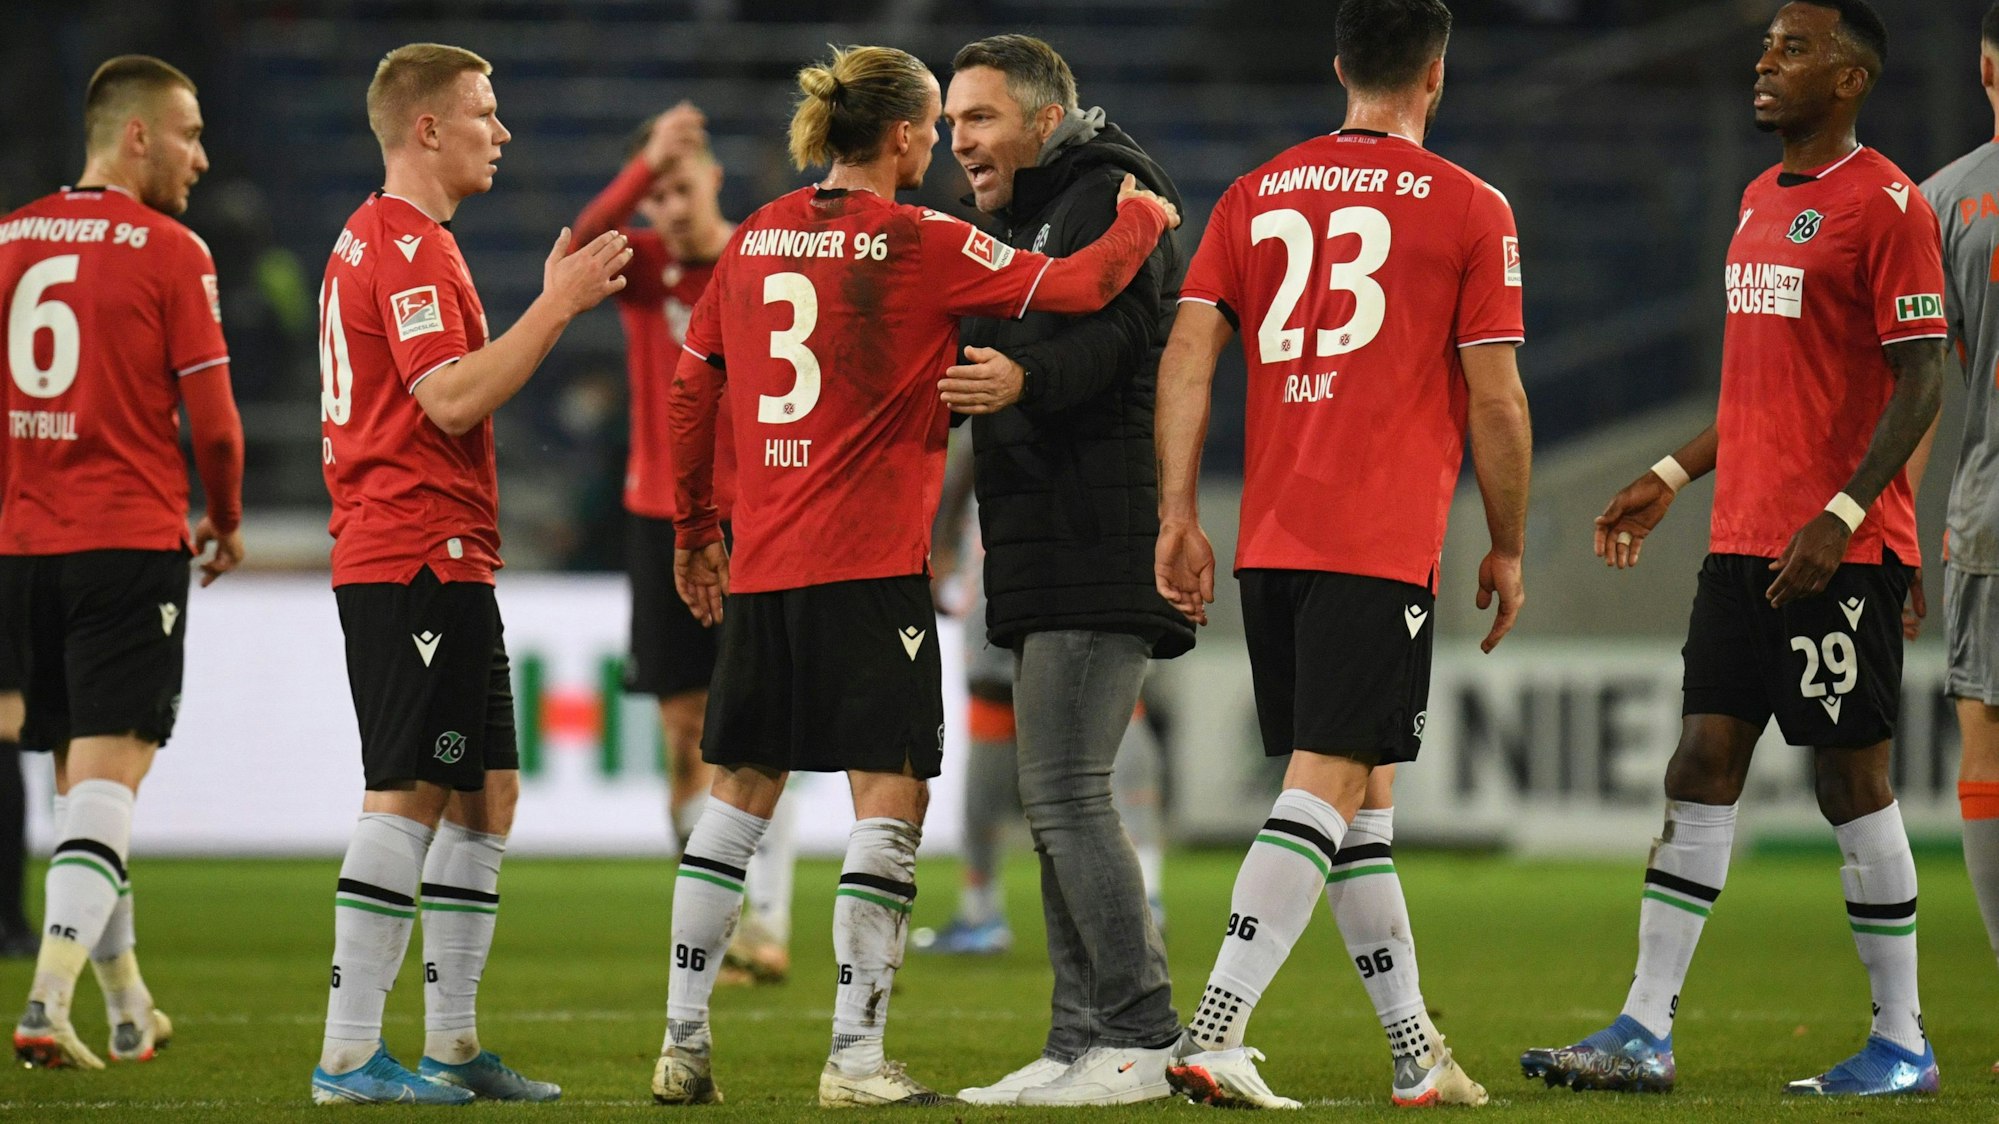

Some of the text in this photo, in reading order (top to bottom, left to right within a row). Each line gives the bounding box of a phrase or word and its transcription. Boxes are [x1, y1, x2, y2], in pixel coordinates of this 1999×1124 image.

[1258, 166, 1432, 199] HANNOVER 96
[113, 222, 149, 249] 96
[740, 229, 888, 260] HANNOVER 96
[345, 238, 367, 267] 96
[1250, 206, 1392, 365] 23
[1725, 263, 1800, 291] BRAIN 247
[1726, 288, 1775, 314] OUSE
[1898, 296, 1941, 319] HDI
[8, 254, 80, 398] 6
[758, 272, 821, 424] 3
[8, 410, 79, 441] TRYBULL
[765, 439, 812, 467] HULT
[1790, 631, 1858, 698] 29
[433, 731, 467, 763] 96
[1227, 913, 1259, 941] 96
[676, 944, 707, 972] 96
[1356, 948, 1393, 979] 96
